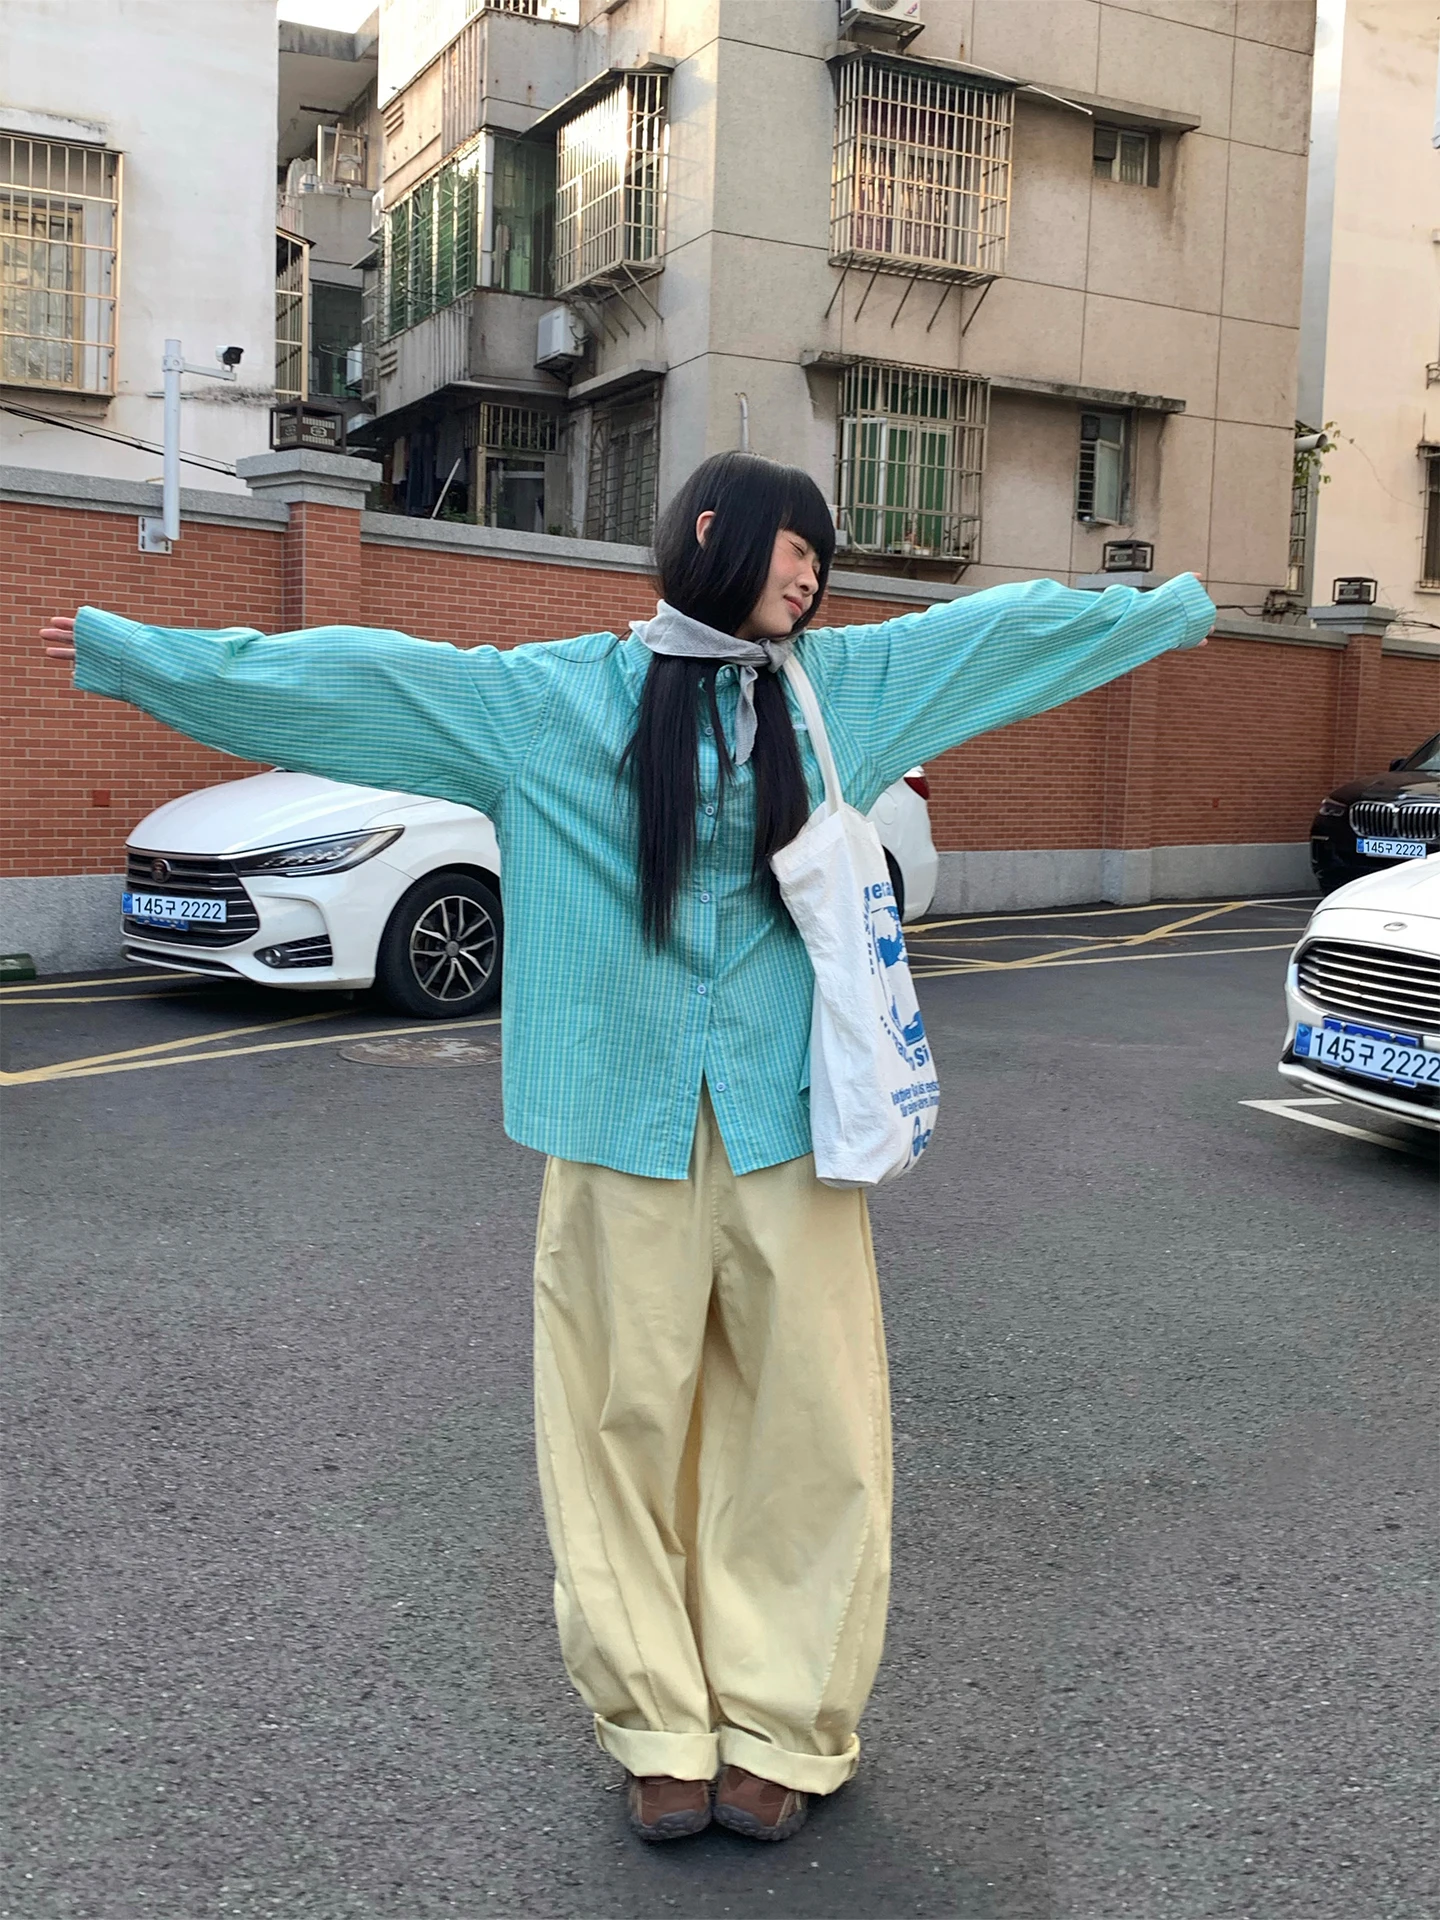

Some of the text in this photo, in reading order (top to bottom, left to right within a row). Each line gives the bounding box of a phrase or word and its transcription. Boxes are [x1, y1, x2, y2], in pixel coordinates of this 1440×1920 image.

[1365, 841, 1423, 856] 145구 2222
[135, 896, 221, 919] 145구 2222
[1315, 1032, 1375, 1066] 145구
[1381, 1047, 1440, 1083] 2222
